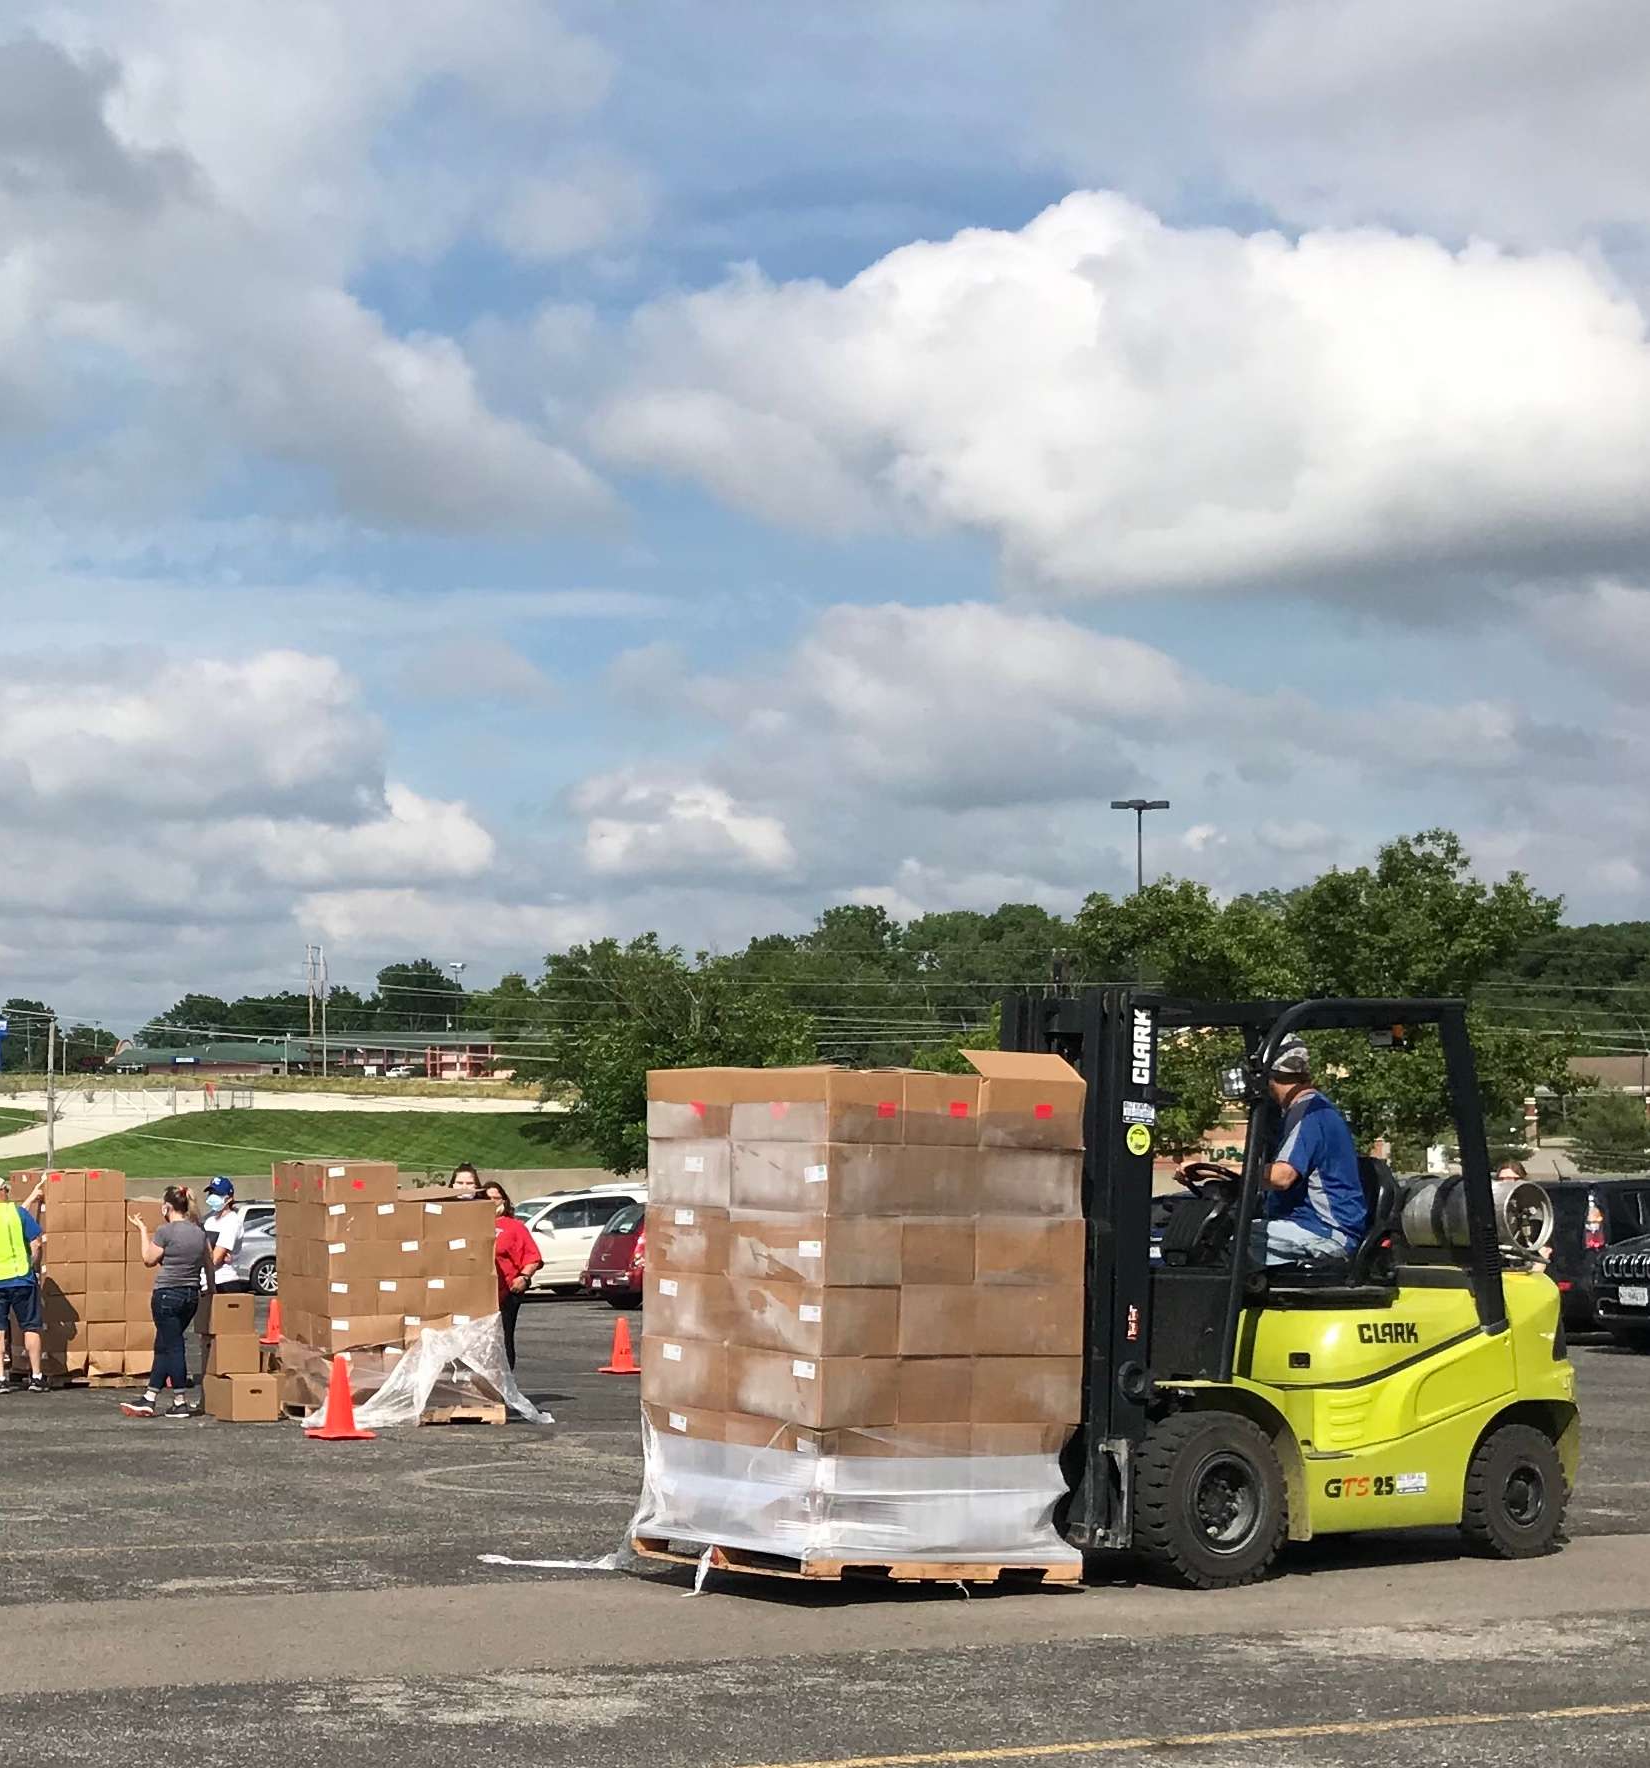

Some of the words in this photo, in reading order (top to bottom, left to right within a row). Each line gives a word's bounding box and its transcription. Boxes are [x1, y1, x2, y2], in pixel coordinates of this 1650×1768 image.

[1132, 1008, 1152, 1085] CLARK
[1357, 1322, 1419, 1344] CLARK
[1324, 1476, 1370, 1499] GTS
[1373, 1475, 1394, 1496] 25
